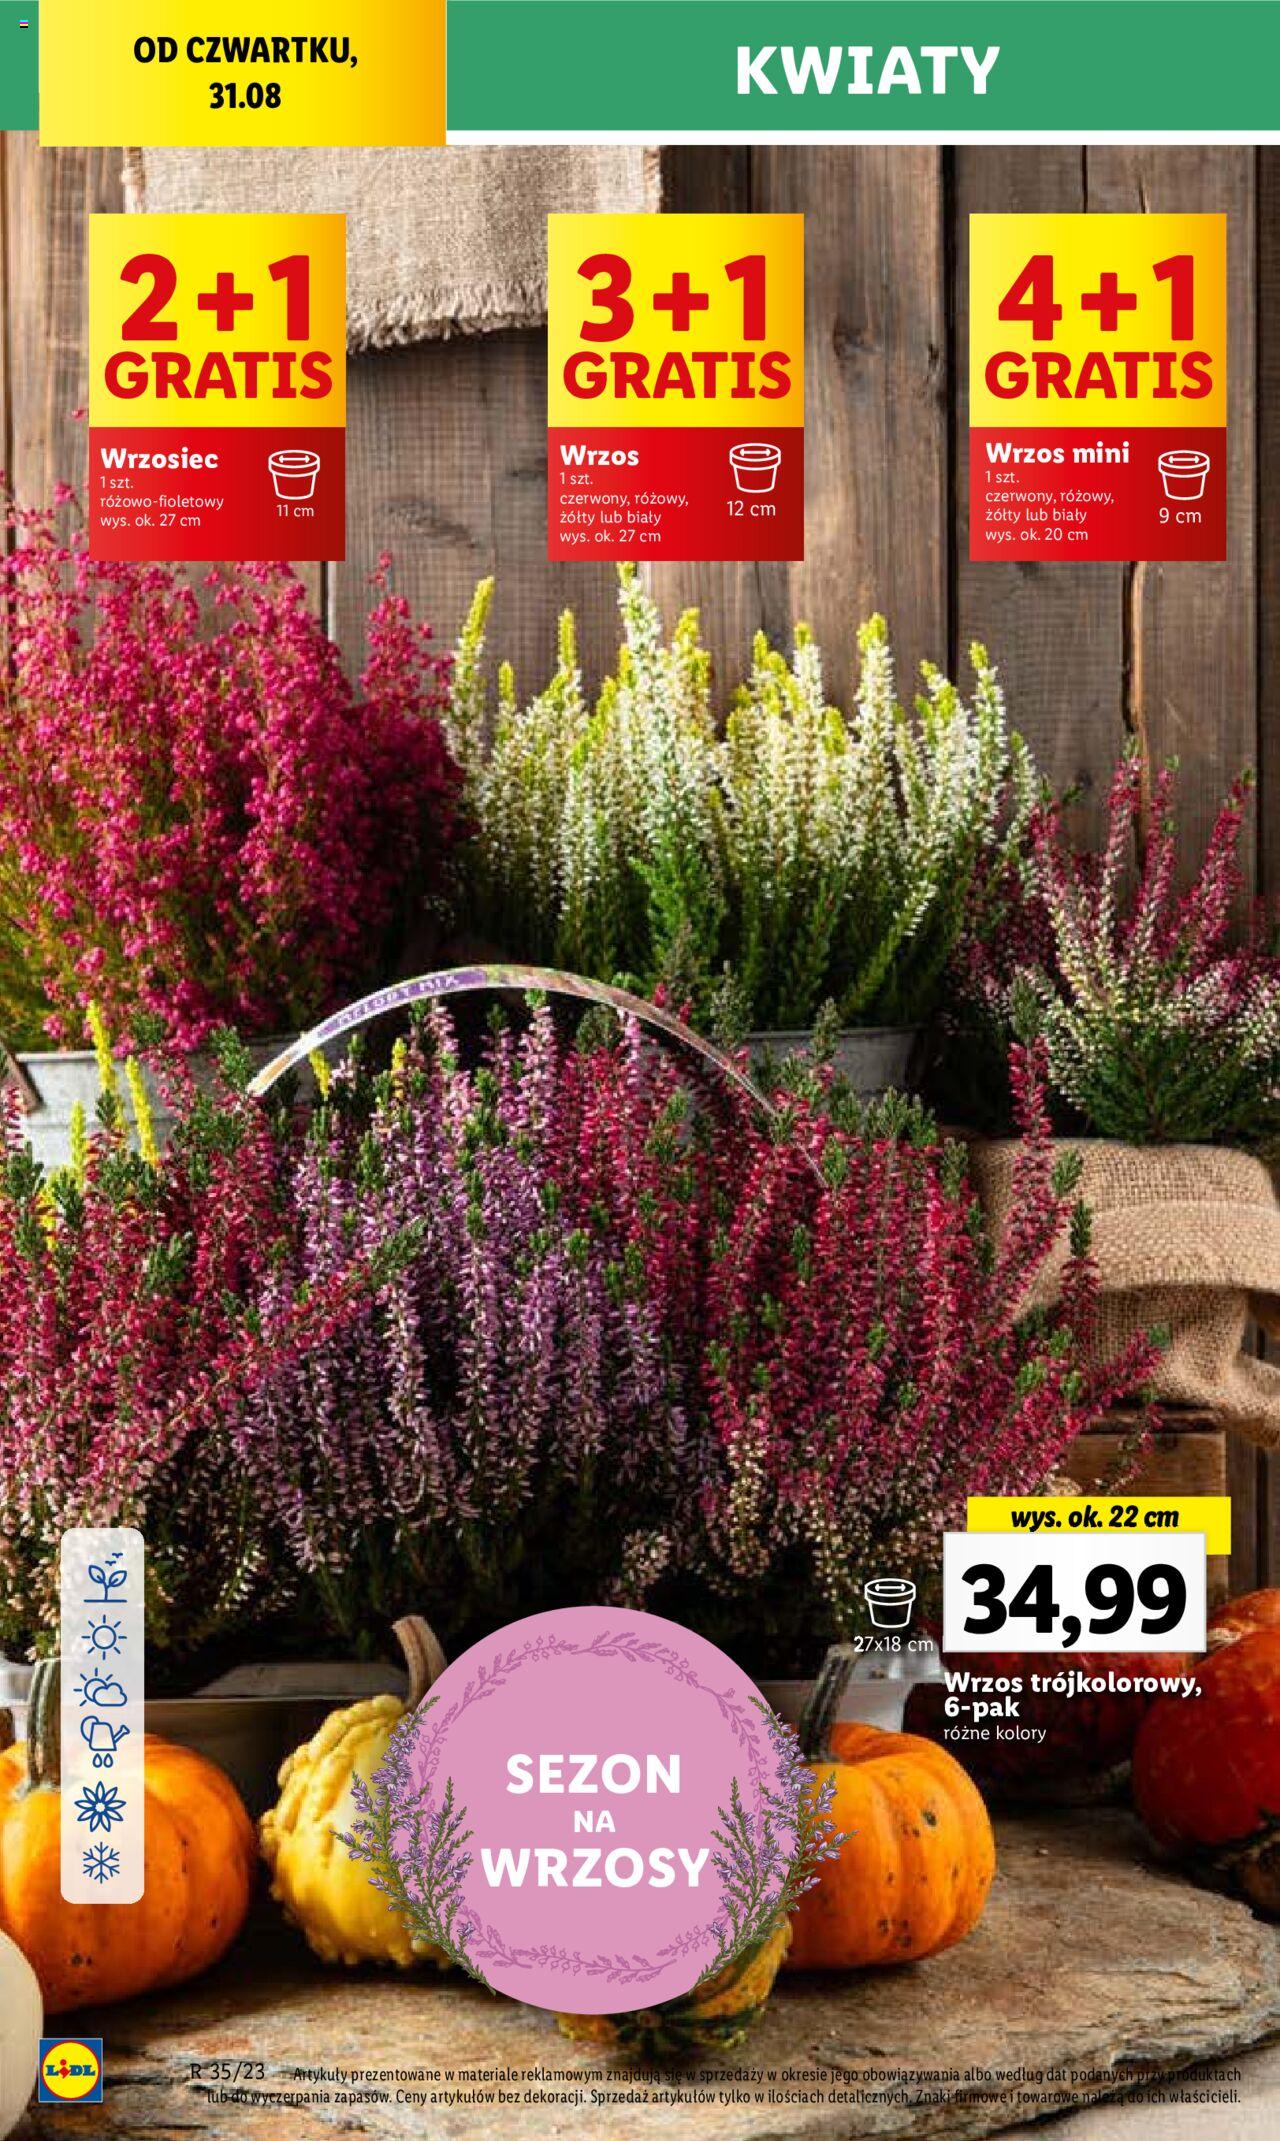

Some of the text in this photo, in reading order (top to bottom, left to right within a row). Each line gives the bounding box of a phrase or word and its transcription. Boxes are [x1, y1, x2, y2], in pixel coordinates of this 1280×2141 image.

[134, 37, 357, 68] OD CZWARTKU,
[738, 47, 999, 94] KWIATY
[210, 83, 281, 109] 31.08
[121, 254, 309, 340] 2+1
[578, 254, 765, 342] 3+1
[999, 255, 1193, 340] 4+1
[105, 351, 332, 399] GRATIS
[564, 351, 791, 399] GRATIS
[985, 351, 1212, 399] GRATIS
[101, 447, 218, 469] Wrzosiec
[560, 445, 639, 466] Wrzos
[986, 441, 1129, 463] Wrzos mini
[101, 476, 133, 488] 1 szt.
[560, 472, 592, 484] 1 szt.
[986, 471, 1019, 483] 1 szt.
[101, 495, 223, 510] różowo-fioletowy
[560, 492, 688, 507] czerwony, różowy,
[986, 490, 1113, 504] czerwony, różowy,
[277, 505, 313, 517] 11 cm
[560, 511, 661, 526] żółty lub biały
[727, 501, 775, 516] 12 cm
[986, 508, 1086, 523] żółty lub biały
[1160, 508, 1201, 523] 9 cm
[101, 514, 200, 529] wys. ok. 27 cm
[560, 530, 660, 545] wys. ok. 27 cm
[986, 528, 1088, 543] wys. ok. 20 cm
[1012, 1505, 1179, 1532] wys. ok. 22 cm
[962, 1564, 1186, 1648] 34,99
[855, 1636, 933, 1652] 27x18 cm
[944, 1671, 1201, 1697] Wrzos trójkolorowy,
[945, 1697, 1019, 1722] 6-pak
[945, 1726, 1045, 1743] różne kolory
[507, 1754, 680, 1794] SEZON
[574, 1810, 615, 1832] NA
[481, 1848, 709, 1888] WRZOSY
[191, 2062, 265, 2083] R 35/23
[293, 2067, 1241, 2084] Artykuły prezentowane w materiale reklamowym znajdują się w sprzedaży w okresie jego obowiązywania albo według dat podanych przy produktach
[207, 2089, 1241, 2107] lub do wyczerpania zapasów. Ceny artykułów bez dekoracji. Sprzedaż artykułów tylko w ilościach detalicznych. Znaki firmowe i towarowe należą do ich właścicieli.
